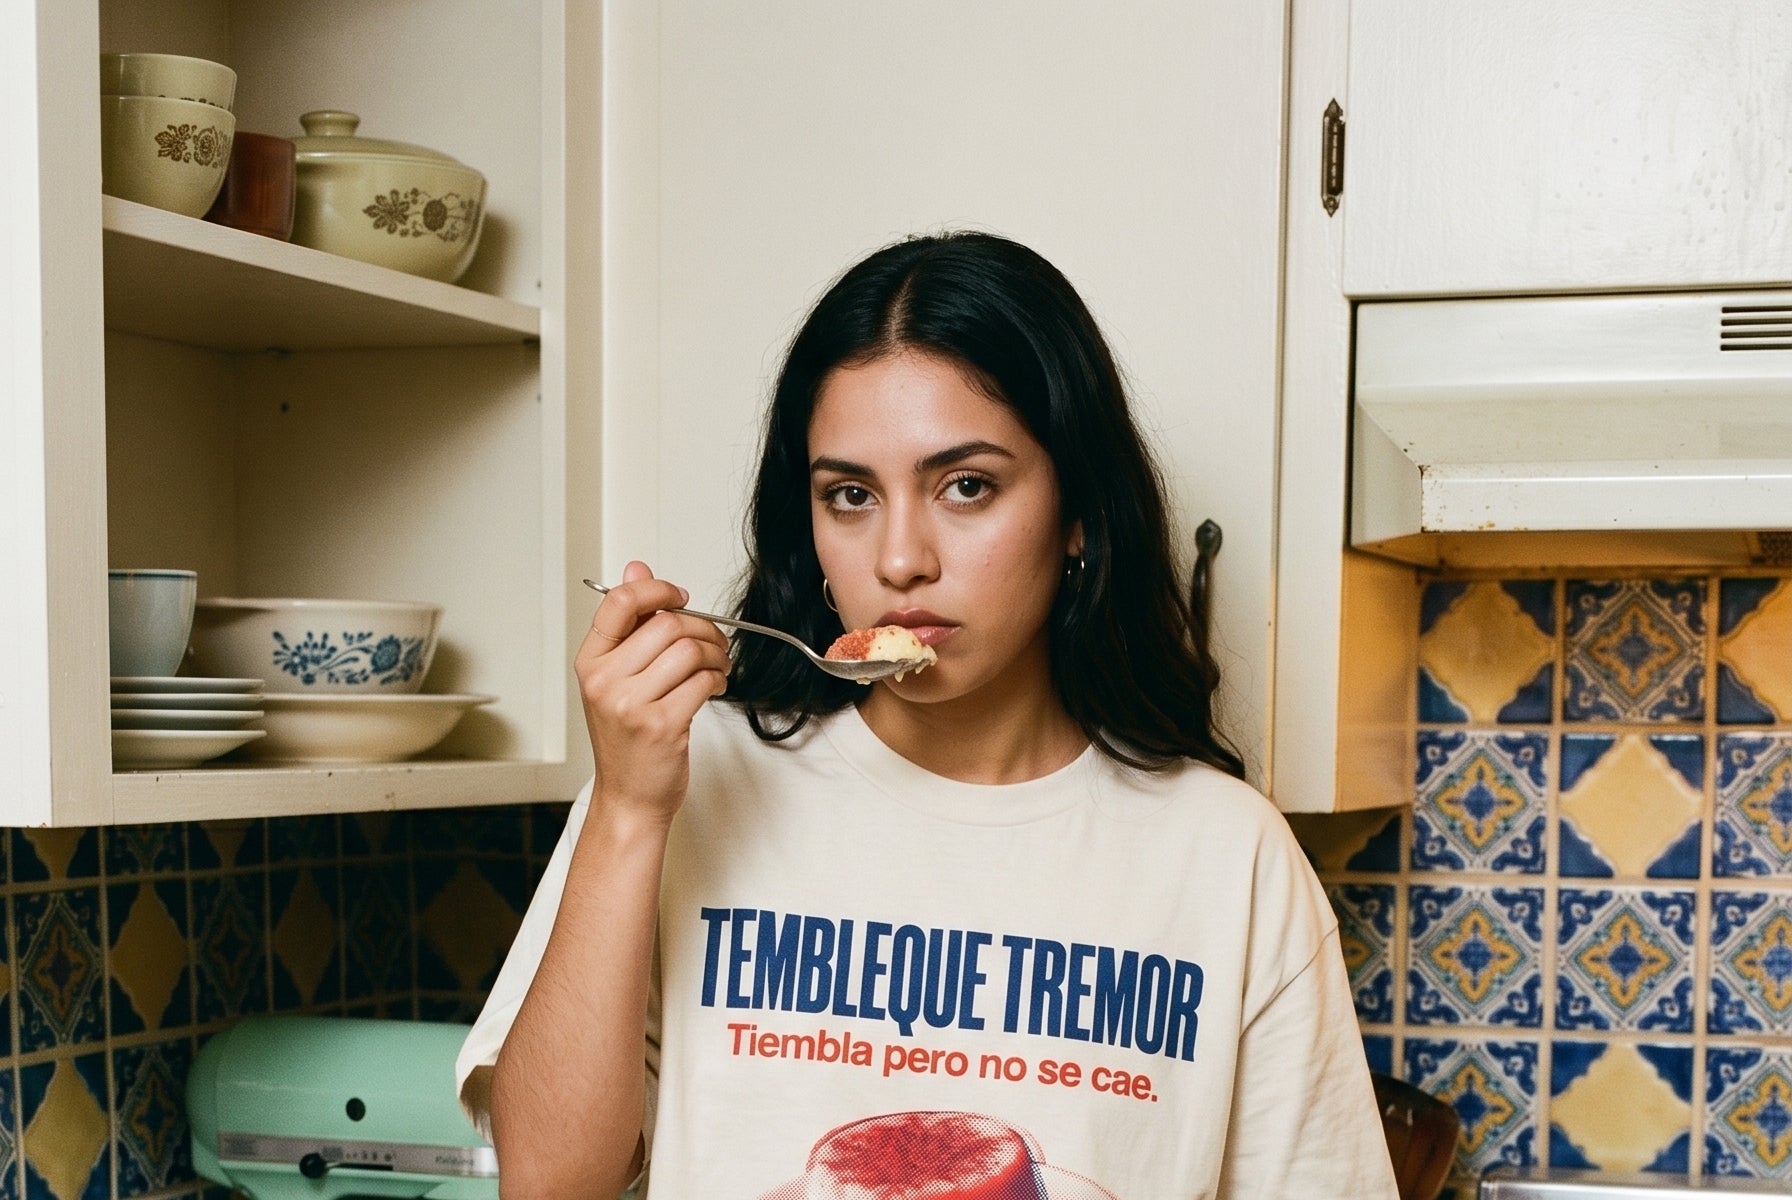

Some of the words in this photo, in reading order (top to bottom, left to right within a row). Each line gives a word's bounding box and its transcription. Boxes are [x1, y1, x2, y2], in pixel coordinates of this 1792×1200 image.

[700, 907, 993, 1037] TEMBLEQUE
[1002, 934, 1204, 1062] TREMOR
[727, 1022, 874, 1067] Tiembla
[882, 1044, 970, 1078] pero
[979, 1054, 1028, 1083] no
[1037, 1058, 1083, 1088] se
[1090, 1065, 1159, 1103] cae.
